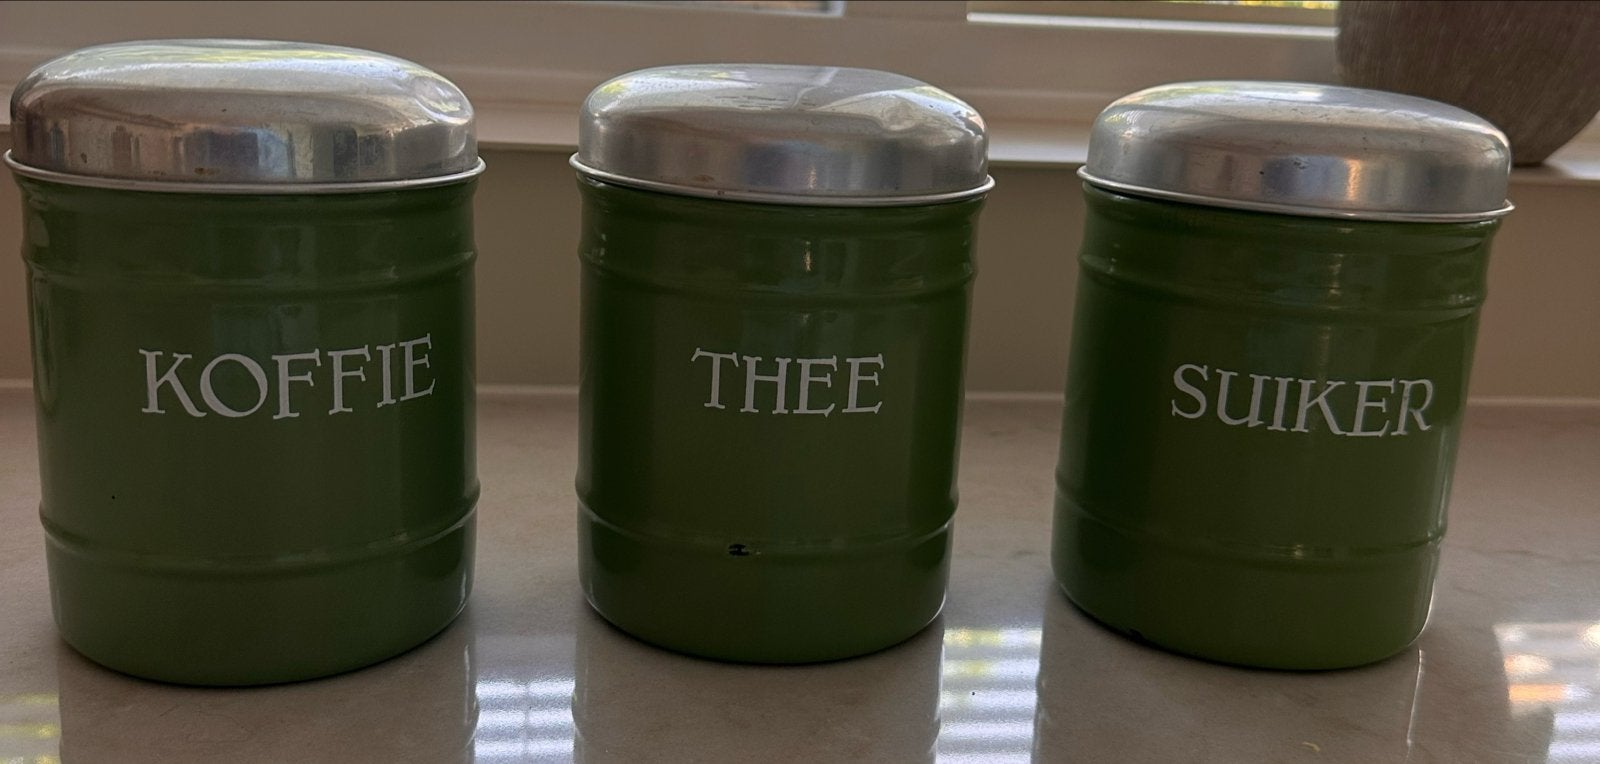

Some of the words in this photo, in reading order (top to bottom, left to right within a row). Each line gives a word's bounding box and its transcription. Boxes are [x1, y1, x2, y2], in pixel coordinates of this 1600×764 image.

[138, 333, 437, 420] KOFFIE
[691, 348, 885, 417] THEE
[1171, 364, 1436, 438] SUIKER
